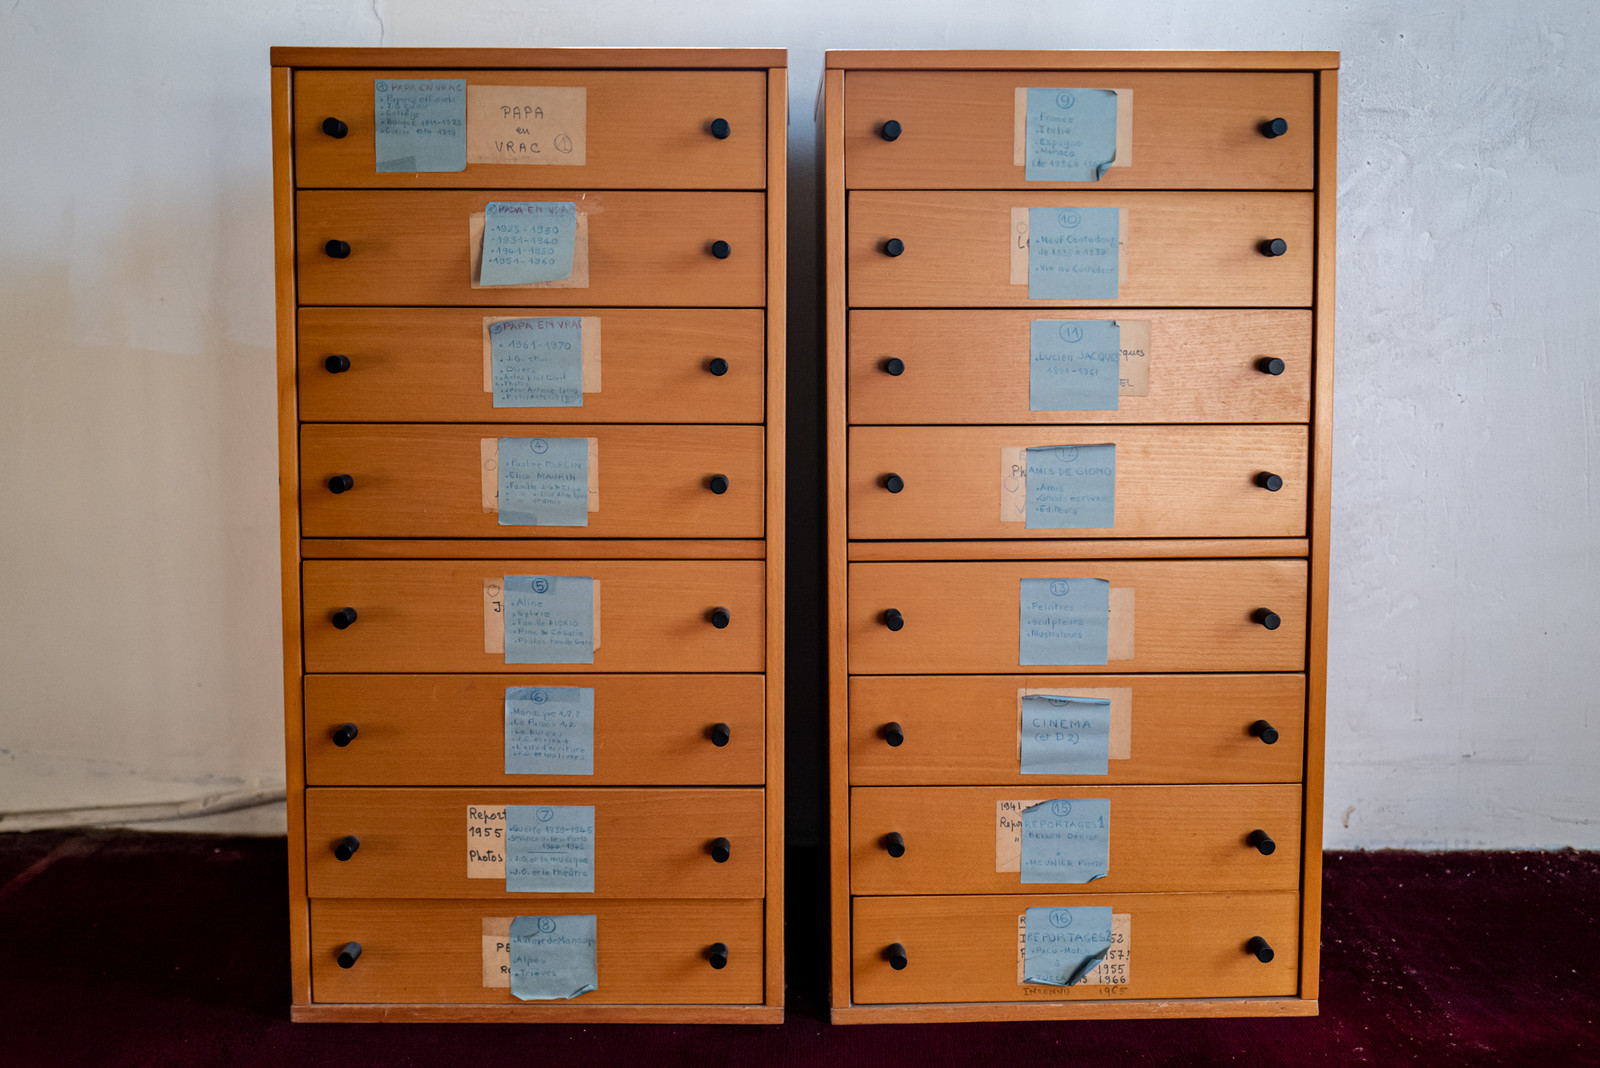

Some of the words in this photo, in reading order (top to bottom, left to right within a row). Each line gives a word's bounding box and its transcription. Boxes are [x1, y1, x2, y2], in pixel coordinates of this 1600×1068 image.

[391, 83, 417, 91] PAPA
[419, 83, 433, 91] EN
[436, 83, 463, 91] VRAC
[500, 105, 544, 120] PAPA
[1040, 112, 1074, 123] France
[516, 126, 535, 136] en
[494, 140, 541, 154] VRAC
[1040, 147, 1075, 157] Monaco
[528, 205, 543, 214] EN
[503, 321, 533, 330] PAPA
[537, 320, 554, 329] EN
[1077, 351, 1119, 363] JACQUES
[1029, 466, 1055, 475] AMIS
[1058, 467, 1072, 476] DE
[1075, 466, 1112, 476] GIONO
[537, 472, 576, 481] MAURIN
[1040, 483, 1064, 492] Amis
[1032, 718, 1091, 730] CINEMA
[1000, 802, 1021, 811] 1941
[1097, 815, 1105, 828] 1
[468, 826, 503, 839] 1955
[469, 850, 503, 863] Photos
[1029, 859, 1074, 867] MEUNIER
[1098, 963, 1124, 975] 1955
[1098, 975, 1127, 985] 1966
